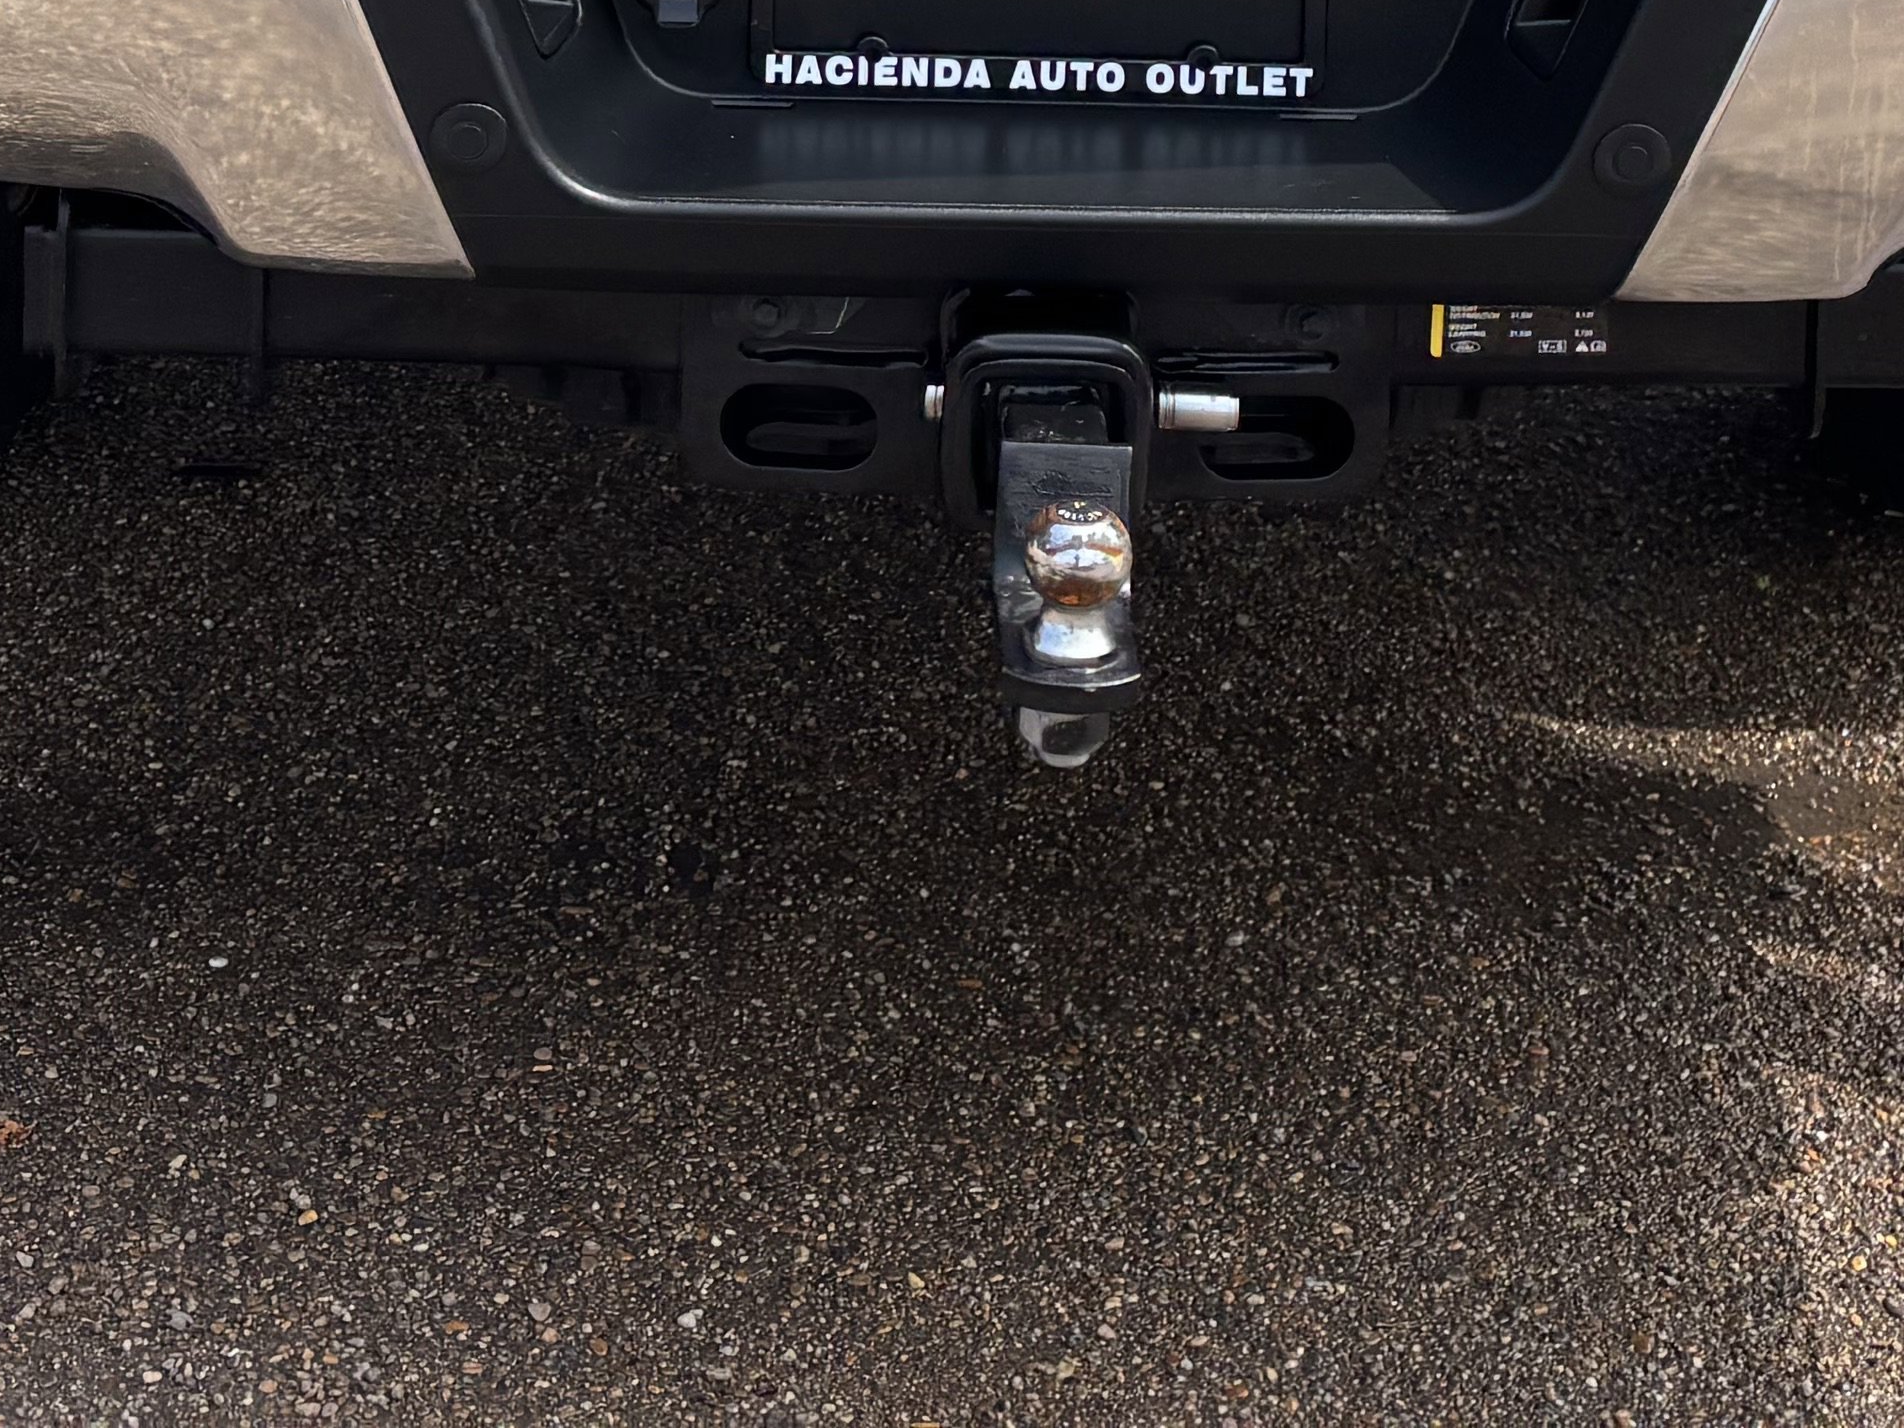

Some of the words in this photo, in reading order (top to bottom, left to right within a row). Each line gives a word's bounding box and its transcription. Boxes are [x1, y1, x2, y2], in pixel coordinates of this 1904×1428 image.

[764, 53, 992, 90] HACIENDA
[1009, 59, 1126, 94] AUTO
[1145, 63, 1314, 98] OUTLET
